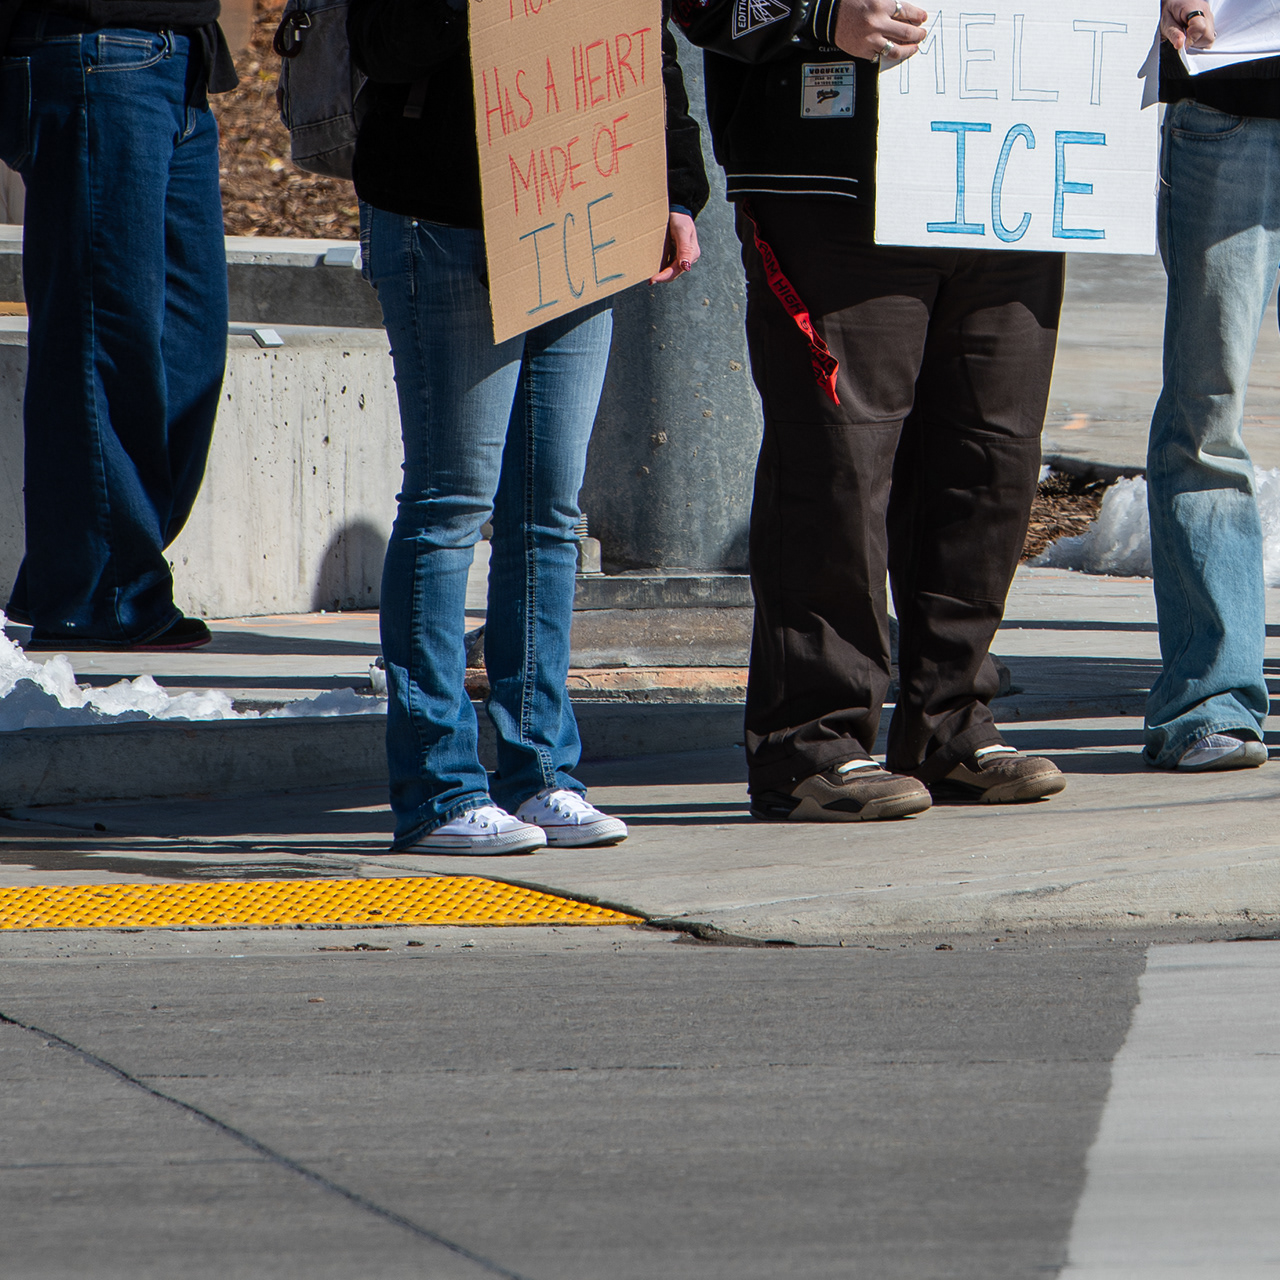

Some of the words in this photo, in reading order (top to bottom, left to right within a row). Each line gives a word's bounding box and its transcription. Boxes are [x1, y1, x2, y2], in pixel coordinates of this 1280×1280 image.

[483, 67, 534, 147] HAS
[546, 58, 561, 114] A
[572, 28, 652, 113] HEART
[899, 9, 1128, 106] MELT
[509, 135, 585, 216] MADE
[592, 114, 634, 177] OF
[926, 120, 1106, 243] ICE
[519, 193, 627, 316] ICE
[772, 278, 805, 314] HIGH
